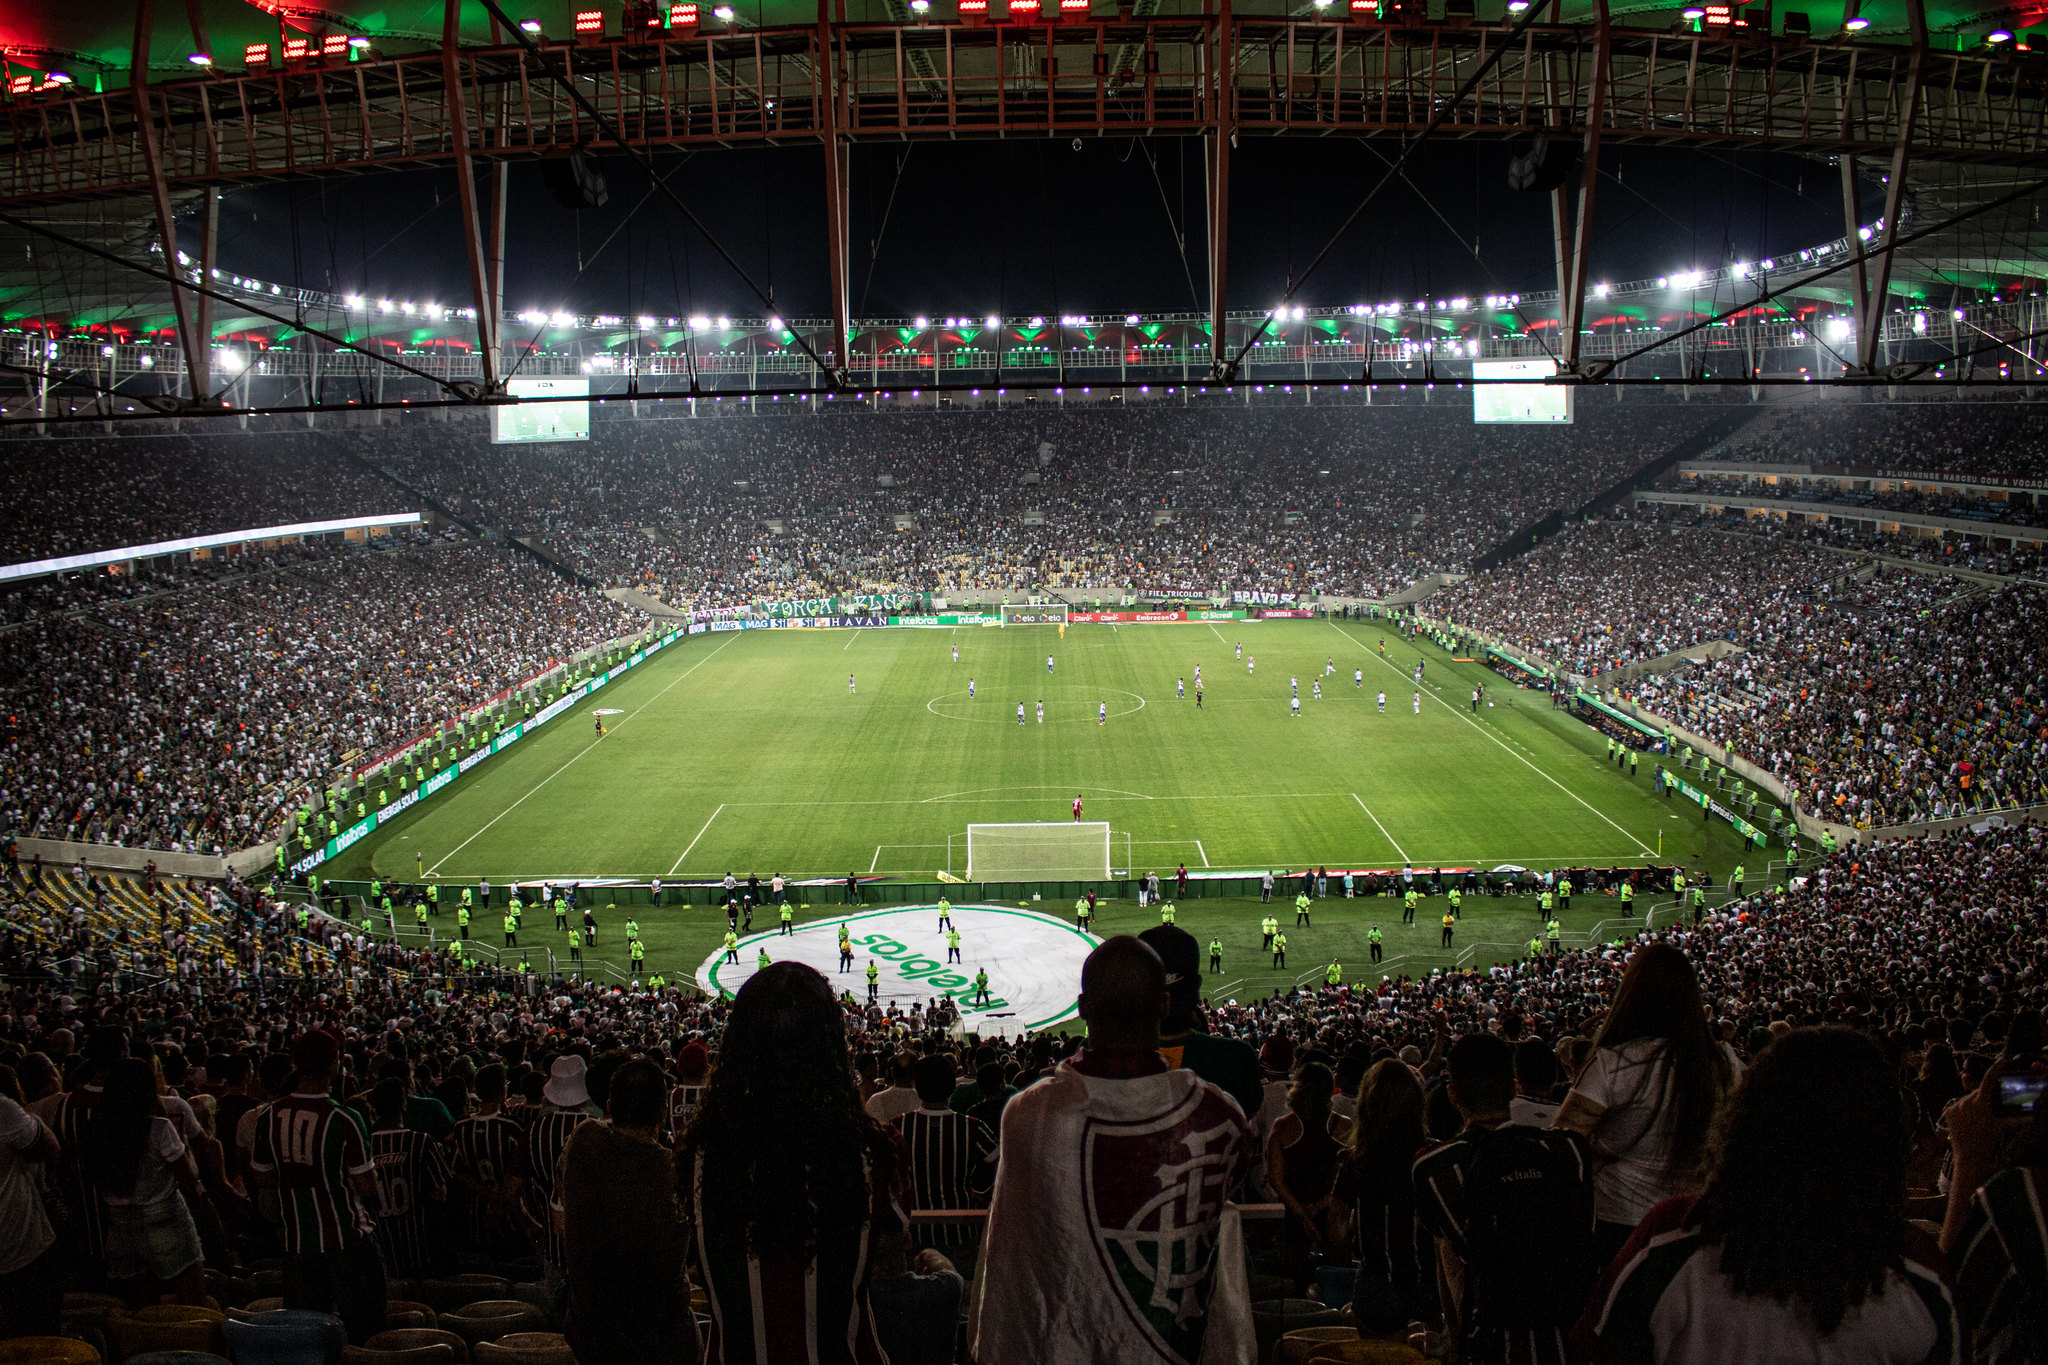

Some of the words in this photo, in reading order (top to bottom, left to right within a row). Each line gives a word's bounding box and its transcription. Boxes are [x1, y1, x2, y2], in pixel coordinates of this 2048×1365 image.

[1886, 471, 1940, 480] FLUMINENSE
[1943, 473, 1977, 483] NASCEU
[1981, 476, 1999, 485] COM
[1167, 590, 1203, 598] TRICOLOR
[714, 622, 736, 630] MAG
[831, 617, 888, 625] HAVAN
[898, 617, 938, 625] intelbras
[958, 615, 997, 625] intelbras
[426, 770, 452, 794] intelbras
[377, 798, 403, 823] ENERGIA
[401, 789, 420, 809] SOLAR
[336, 822, 369, 853] intelbras
[302, 848, 326, 872] SOLAR
[850, 934, 1010, 1015] intelbras
[277, 1107, 319, 1166] 10
